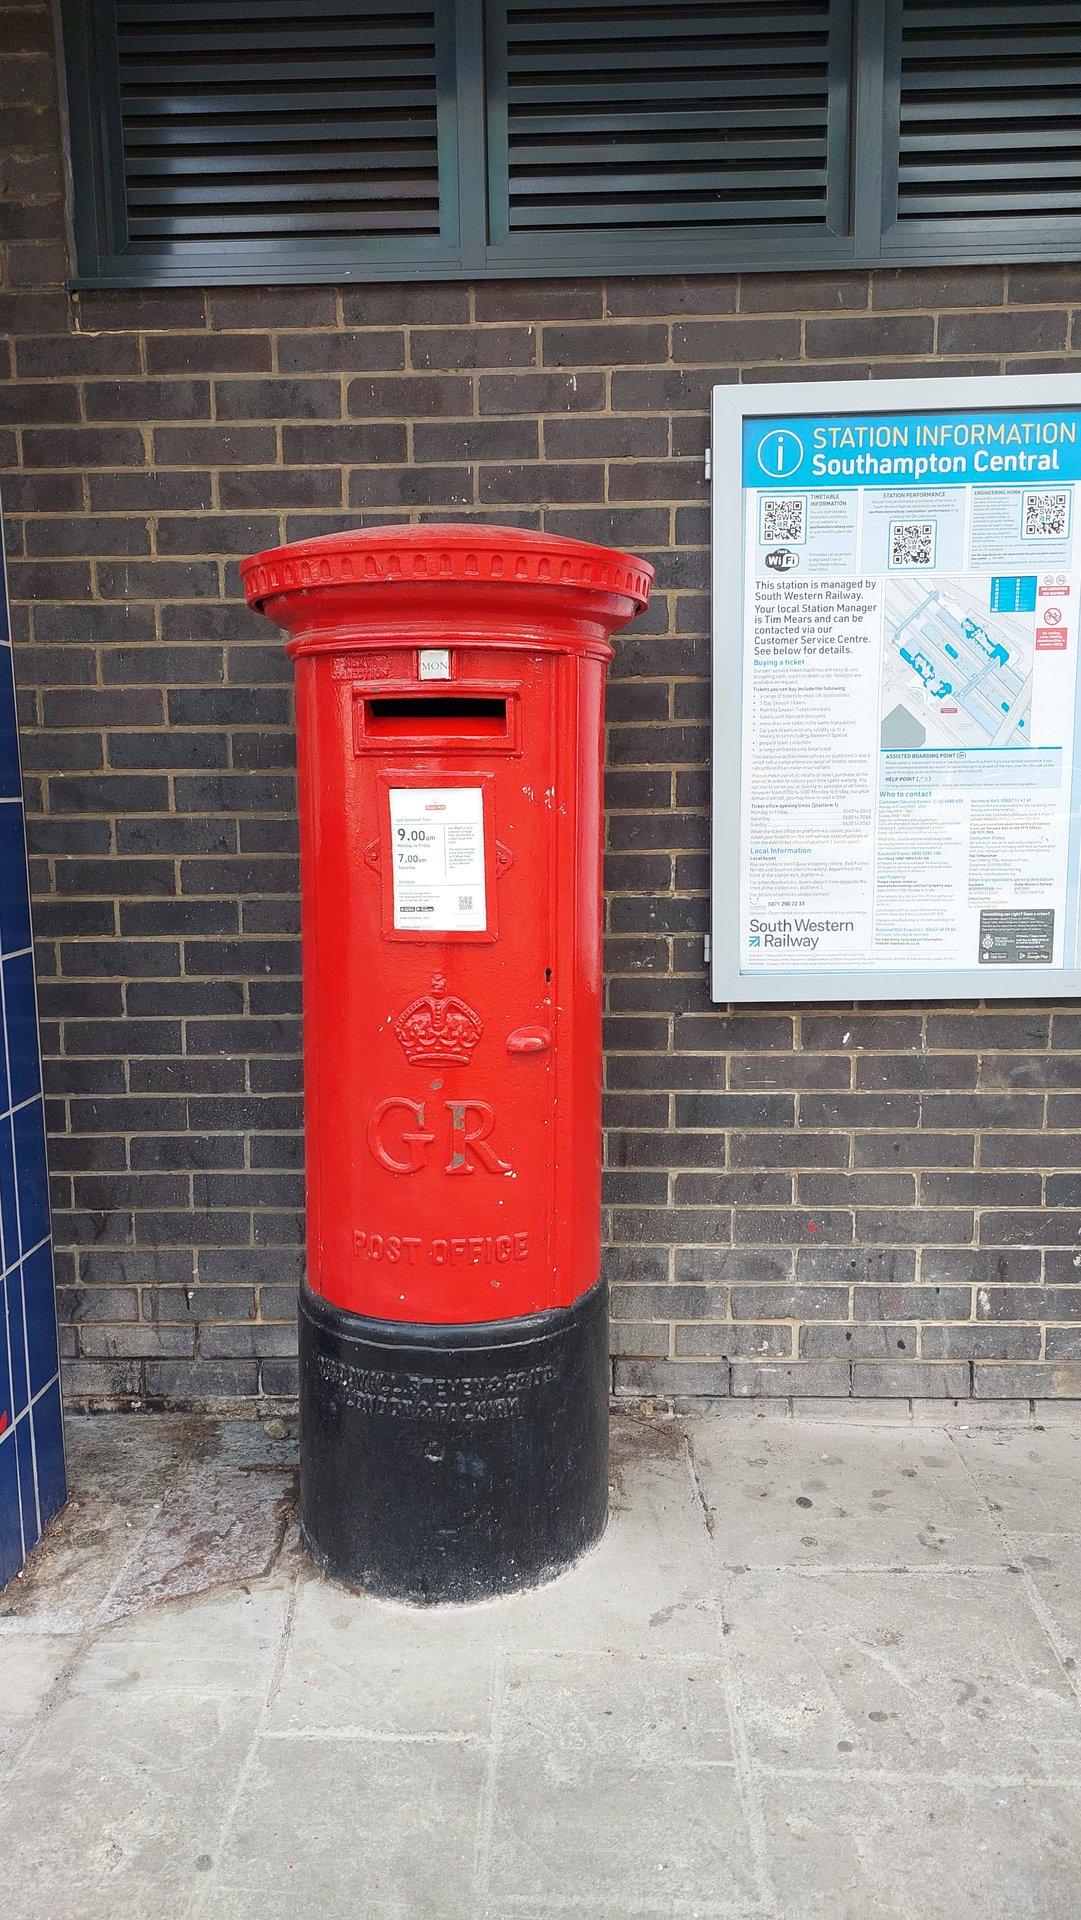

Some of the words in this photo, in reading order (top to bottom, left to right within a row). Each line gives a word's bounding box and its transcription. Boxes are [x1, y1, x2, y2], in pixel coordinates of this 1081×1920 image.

[813, 426, 909, 449] STATION
[915, 422, 1076, 447] INFORMATION
[811, 452, 966, 480] Southampton
[973, 448, 1060, 472] Central
[755, 580, 775, 590] This
[776, 580, 809, 589] station
[811, 580, 819, 589] is
[820, 579, 863, 591] managed
[865, 579, 876, 590] by
[755, 592, 782, 601] South
[784, 591, 823, 601] Western
[825, 590, 864, 601] Railway.
[755, 605, 775, 614] Your
[777, 604, 800, 613] local
[801, 604, 834, 613] Station
[836, 603, 877, 614] Manager
[754, 615, 762, 624] is
[765, 615, 781, 624] Tim
[784, 615, 812, 624] Mears
[814, 614, 831, 623] and
[833, 615, 850, 623] can
[852, 614, 864, 623] be
[754, 626, 800, 635] contacted
[801, 626, 815, 634] via
[817, 626, 833, 634] our
[754, 636, 799, 645] Customer
[800, 635, 835, 644] Service
[837, 634, 871, 644] Centre.
[754, 646, 771, 656] See
[773, 646, 801, 655] below
[803, 646, 817, 655] for
[819, 645, 853, 654] details.
[421, 660, 448, 671] MON
[753, 659, 778, 667] Buying
[749, 919, 792, 933] South
[794, 918, 854, 932] Western
[764, 933, 819, 951] Railway
[366, 1096, 513, 1175] GR
[353, 1230, 422, 1265] POST
[432, 1231, 530, 1266] OFFICE
